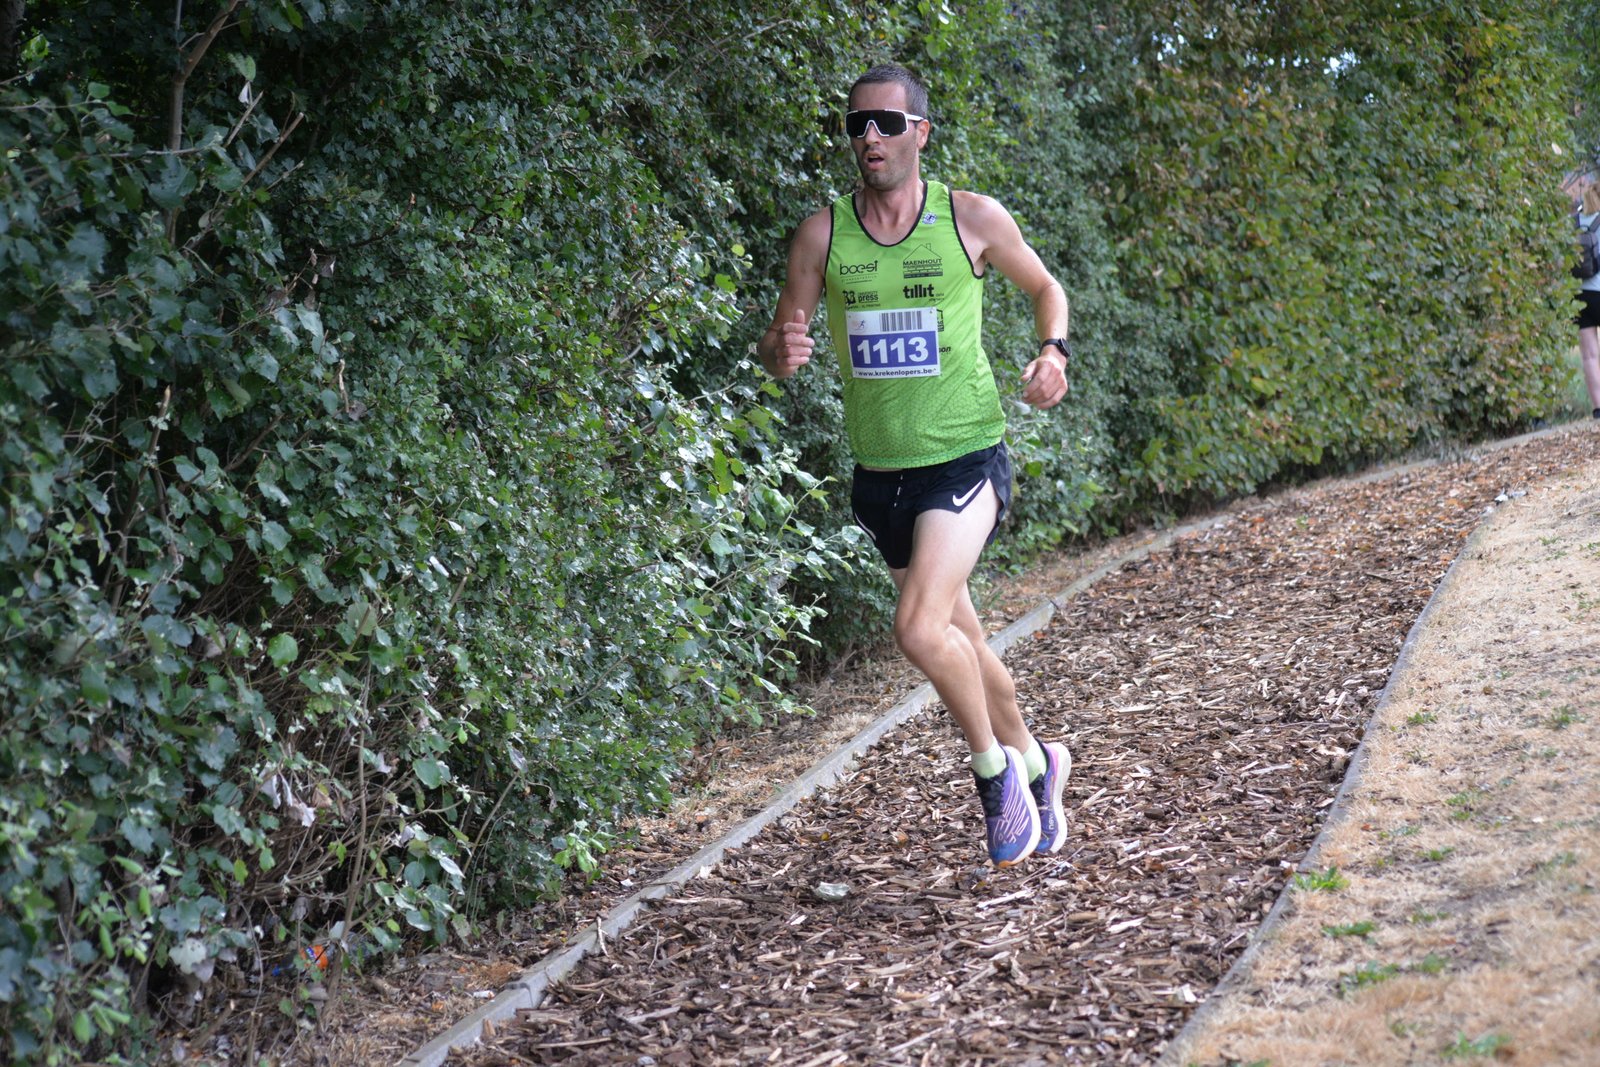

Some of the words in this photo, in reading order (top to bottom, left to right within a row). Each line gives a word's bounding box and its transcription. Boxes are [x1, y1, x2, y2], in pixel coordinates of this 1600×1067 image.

[903, 284, 934, 298] tillit
[858, 294, 878, 303] press
[857, 337, 929, 364] 1113
[858, 369, 932, 377] www.krekenlopers.be
